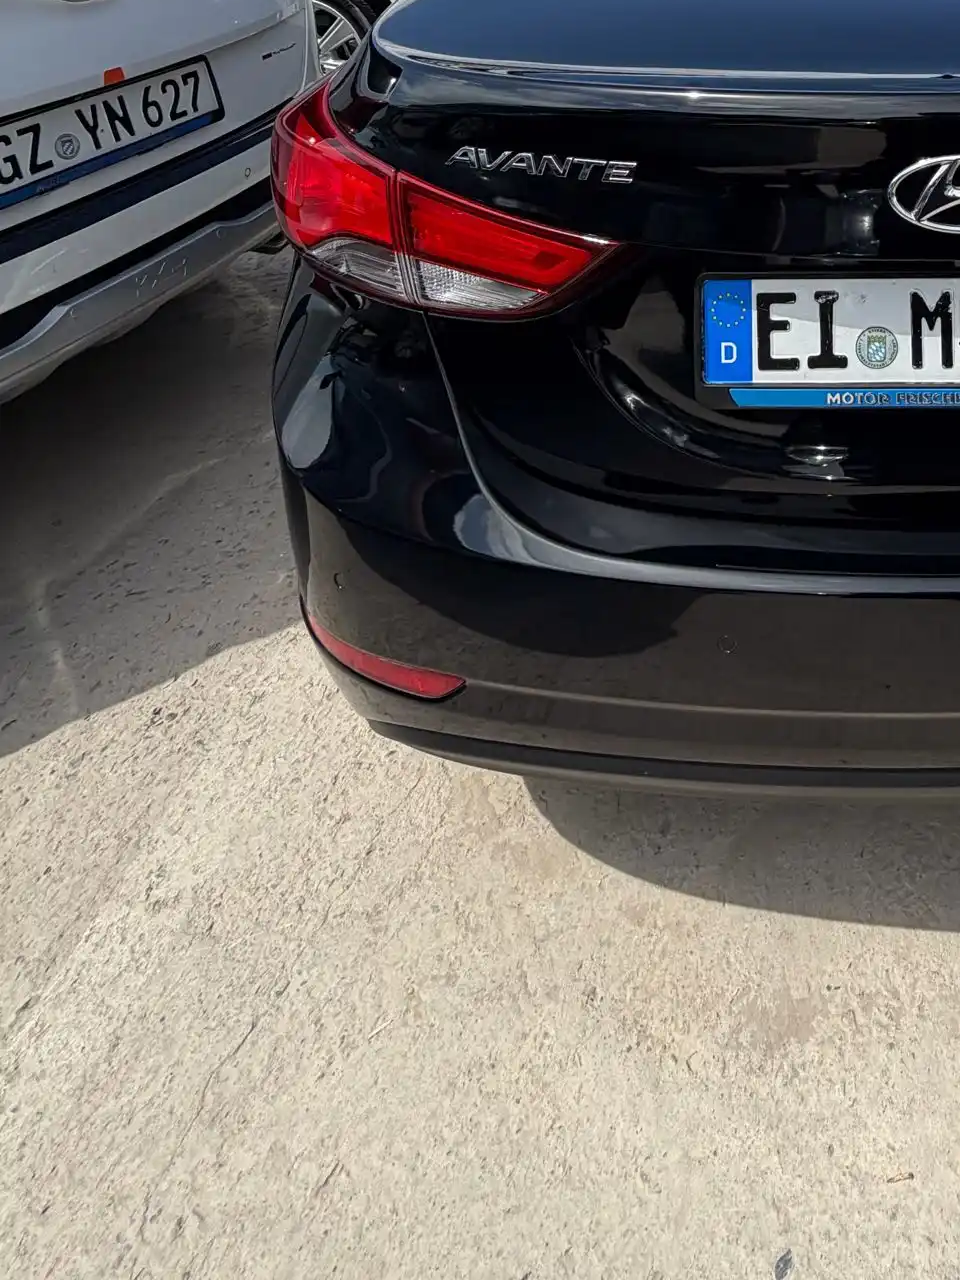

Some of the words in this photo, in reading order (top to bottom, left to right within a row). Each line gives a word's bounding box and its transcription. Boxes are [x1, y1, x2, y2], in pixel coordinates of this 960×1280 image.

[75, 94, 136, 150] YN
[142, 70, 200, 128] 627
[444, 145, 638, 184] AVANTE
[756, 290, 850, 371] EI
[720, 341, 738, 365] D
[826, 391, 890, 405] MOTOR
